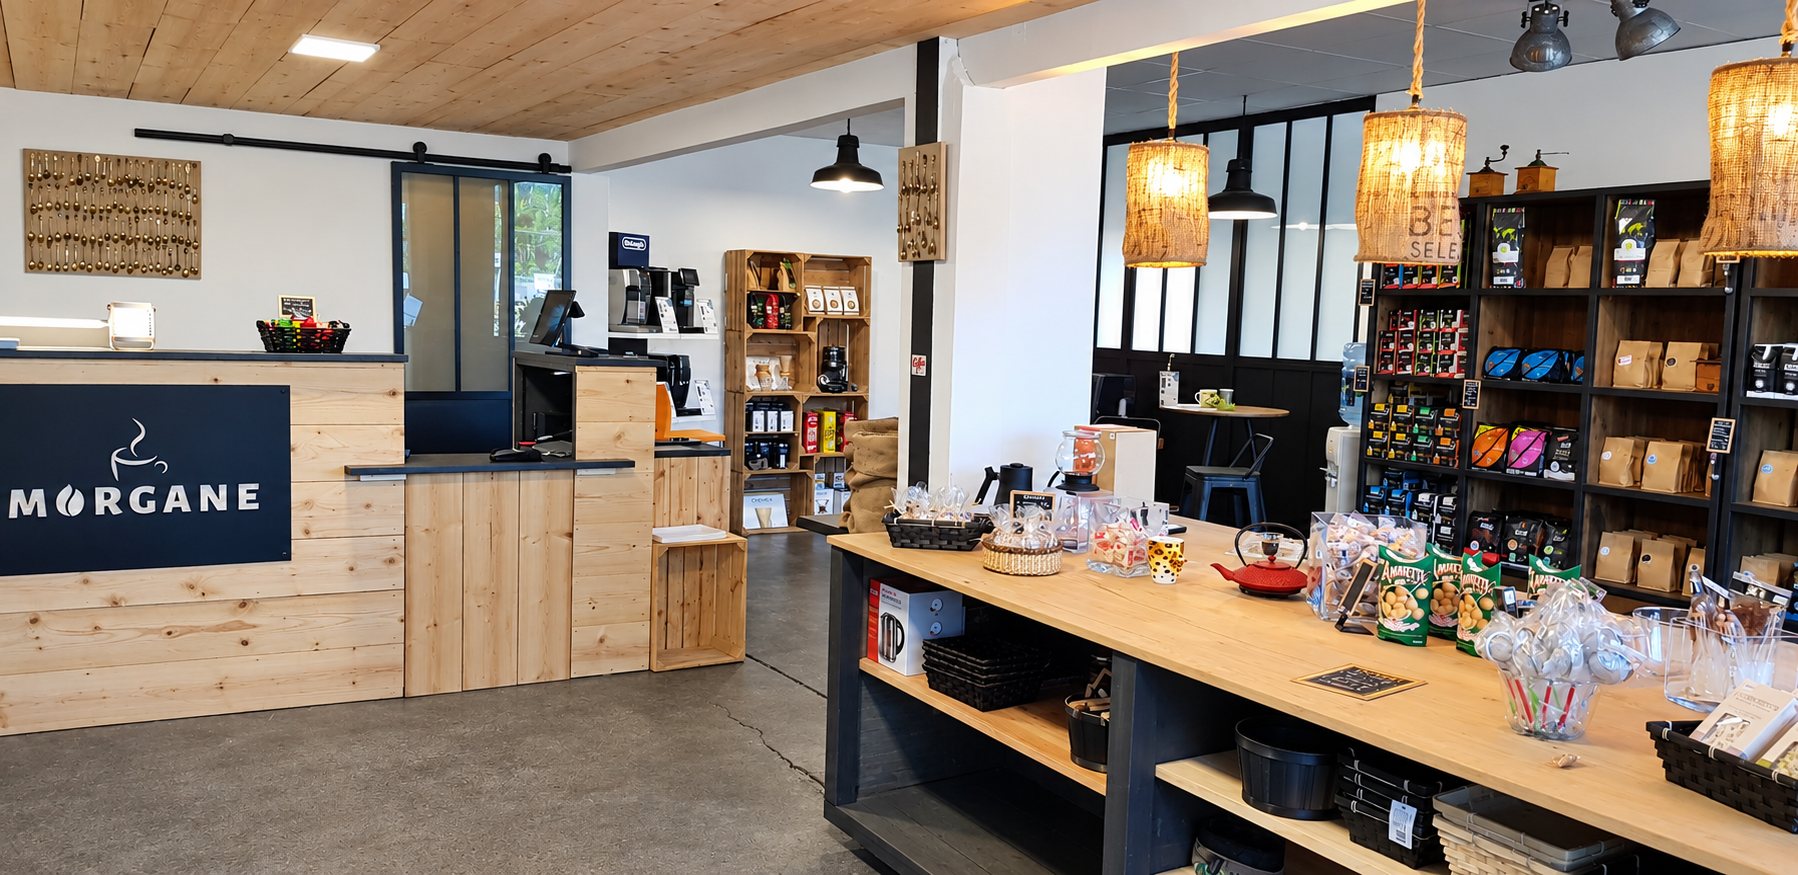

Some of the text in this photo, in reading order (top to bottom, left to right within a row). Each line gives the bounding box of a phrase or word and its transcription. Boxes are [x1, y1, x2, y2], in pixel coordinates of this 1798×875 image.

[1409, 205, 1461, 238] BE
[1410, 241, 1460, 259] SELE
[8, 483, 260, 519] MORGANE
